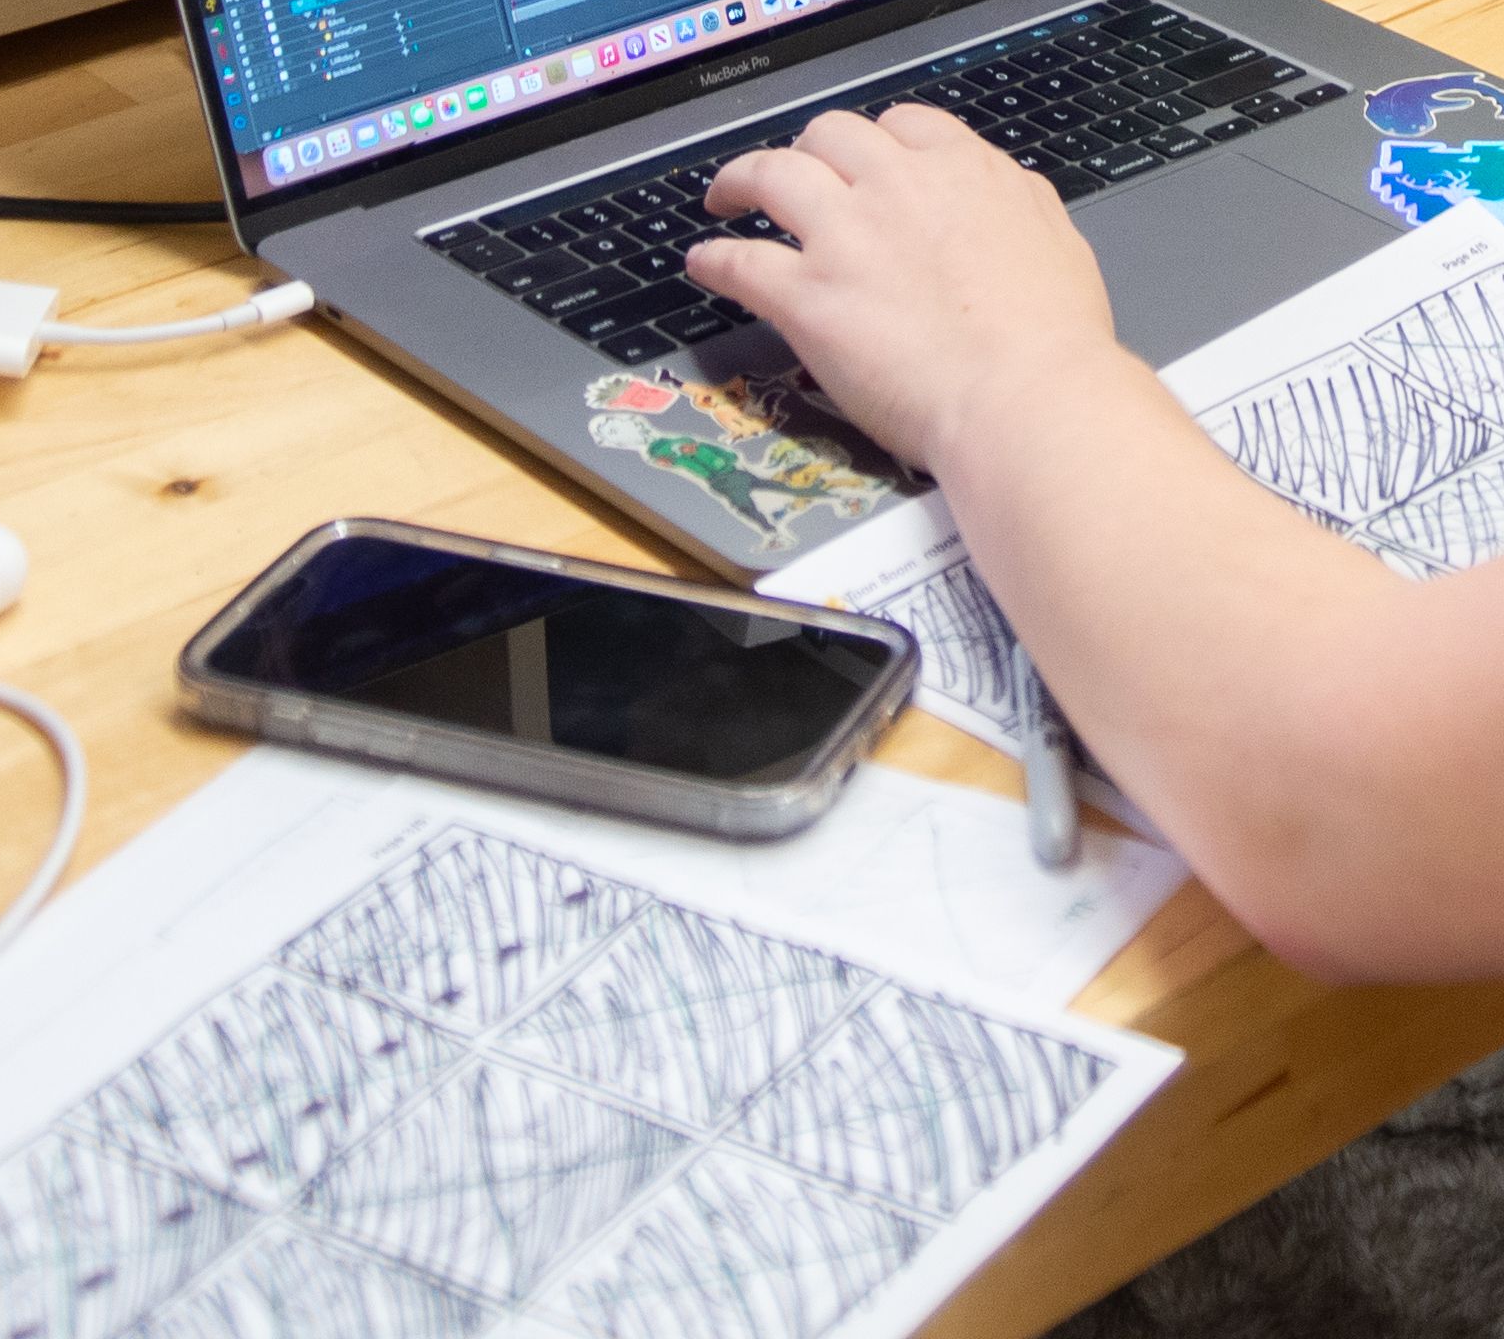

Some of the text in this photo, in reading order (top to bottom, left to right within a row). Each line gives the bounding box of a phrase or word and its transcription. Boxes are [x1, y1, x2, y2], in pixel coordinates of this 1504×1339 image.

[1151, 12, 1179, 28] delete
[1228, 48, 1257, 64] return
[699, 52, 772, 88] MacBook Pro
[1273, 66, 1296, 80] shift
[524, 73, 540, 90] 15
[1168, 137, 1199, 154] option
[1109, 154, 1154, 176] command
[1441, 250, 1470, 273] Page
[512, 276, 533, 288] tab
[589, 318, 616, 334] shift
